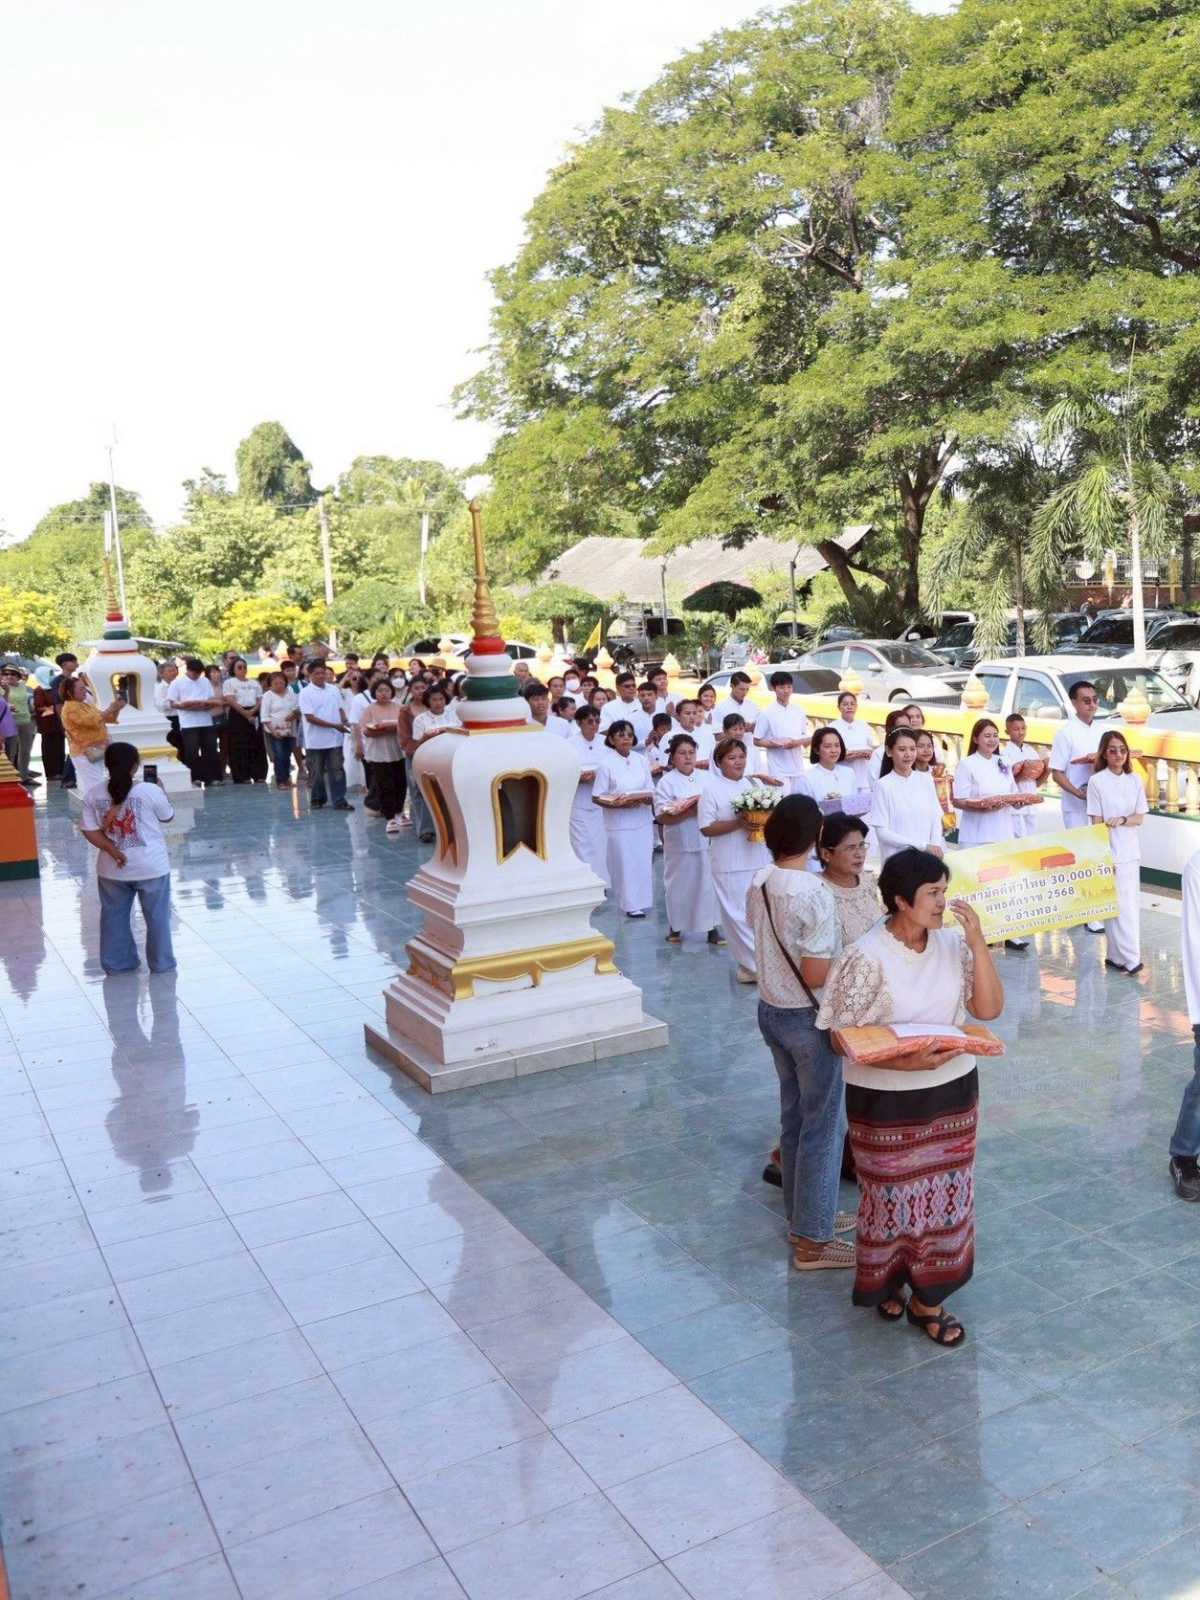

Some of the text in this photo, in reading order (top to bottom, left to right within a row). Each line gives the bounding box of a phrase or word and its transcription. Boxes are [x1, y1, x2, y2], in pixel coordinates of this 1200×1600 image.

[1051, 868, 1092, 884] 30,000
[1097, 864, 1111, 876] วัด
[985, 886, 1075, 914] พุทธศักราช 2568
[1004, 904, 1058, 922] จ.อ่างทอง
